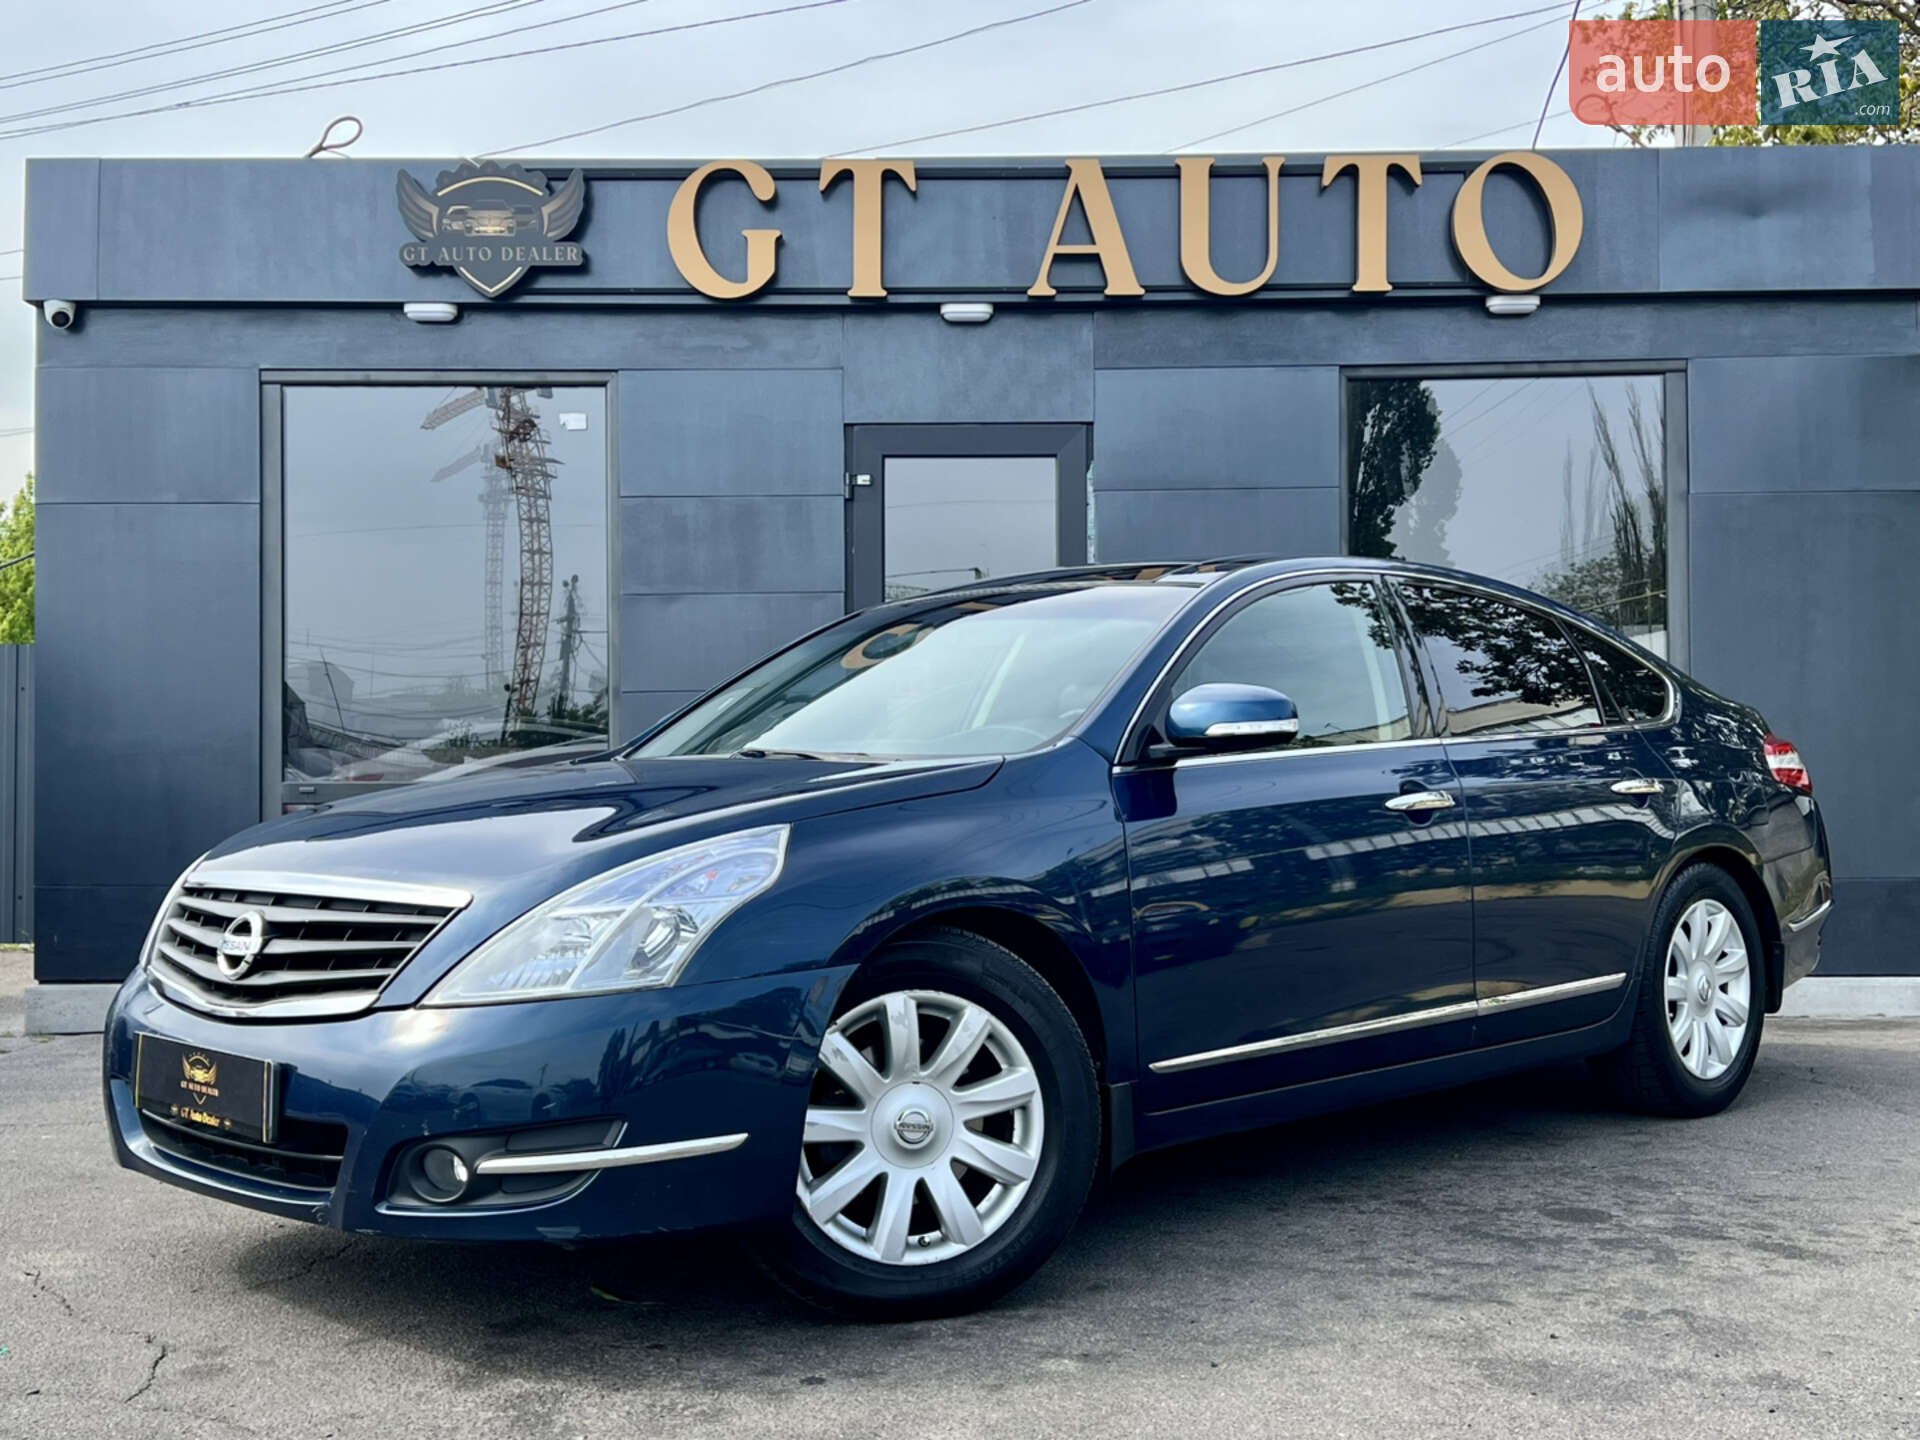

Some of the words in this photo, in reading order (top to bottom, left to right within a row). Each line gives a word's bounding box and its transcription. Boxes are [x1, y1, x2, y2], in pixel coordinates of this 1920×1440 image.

[403, 246, 428, 262] GT
[438, 246, 493, 262] AUTO
[501, 246, 578, 262] DEALER
[667, 158, 917, 298] GT
[1027, 151, 1584, 296] AUTO
